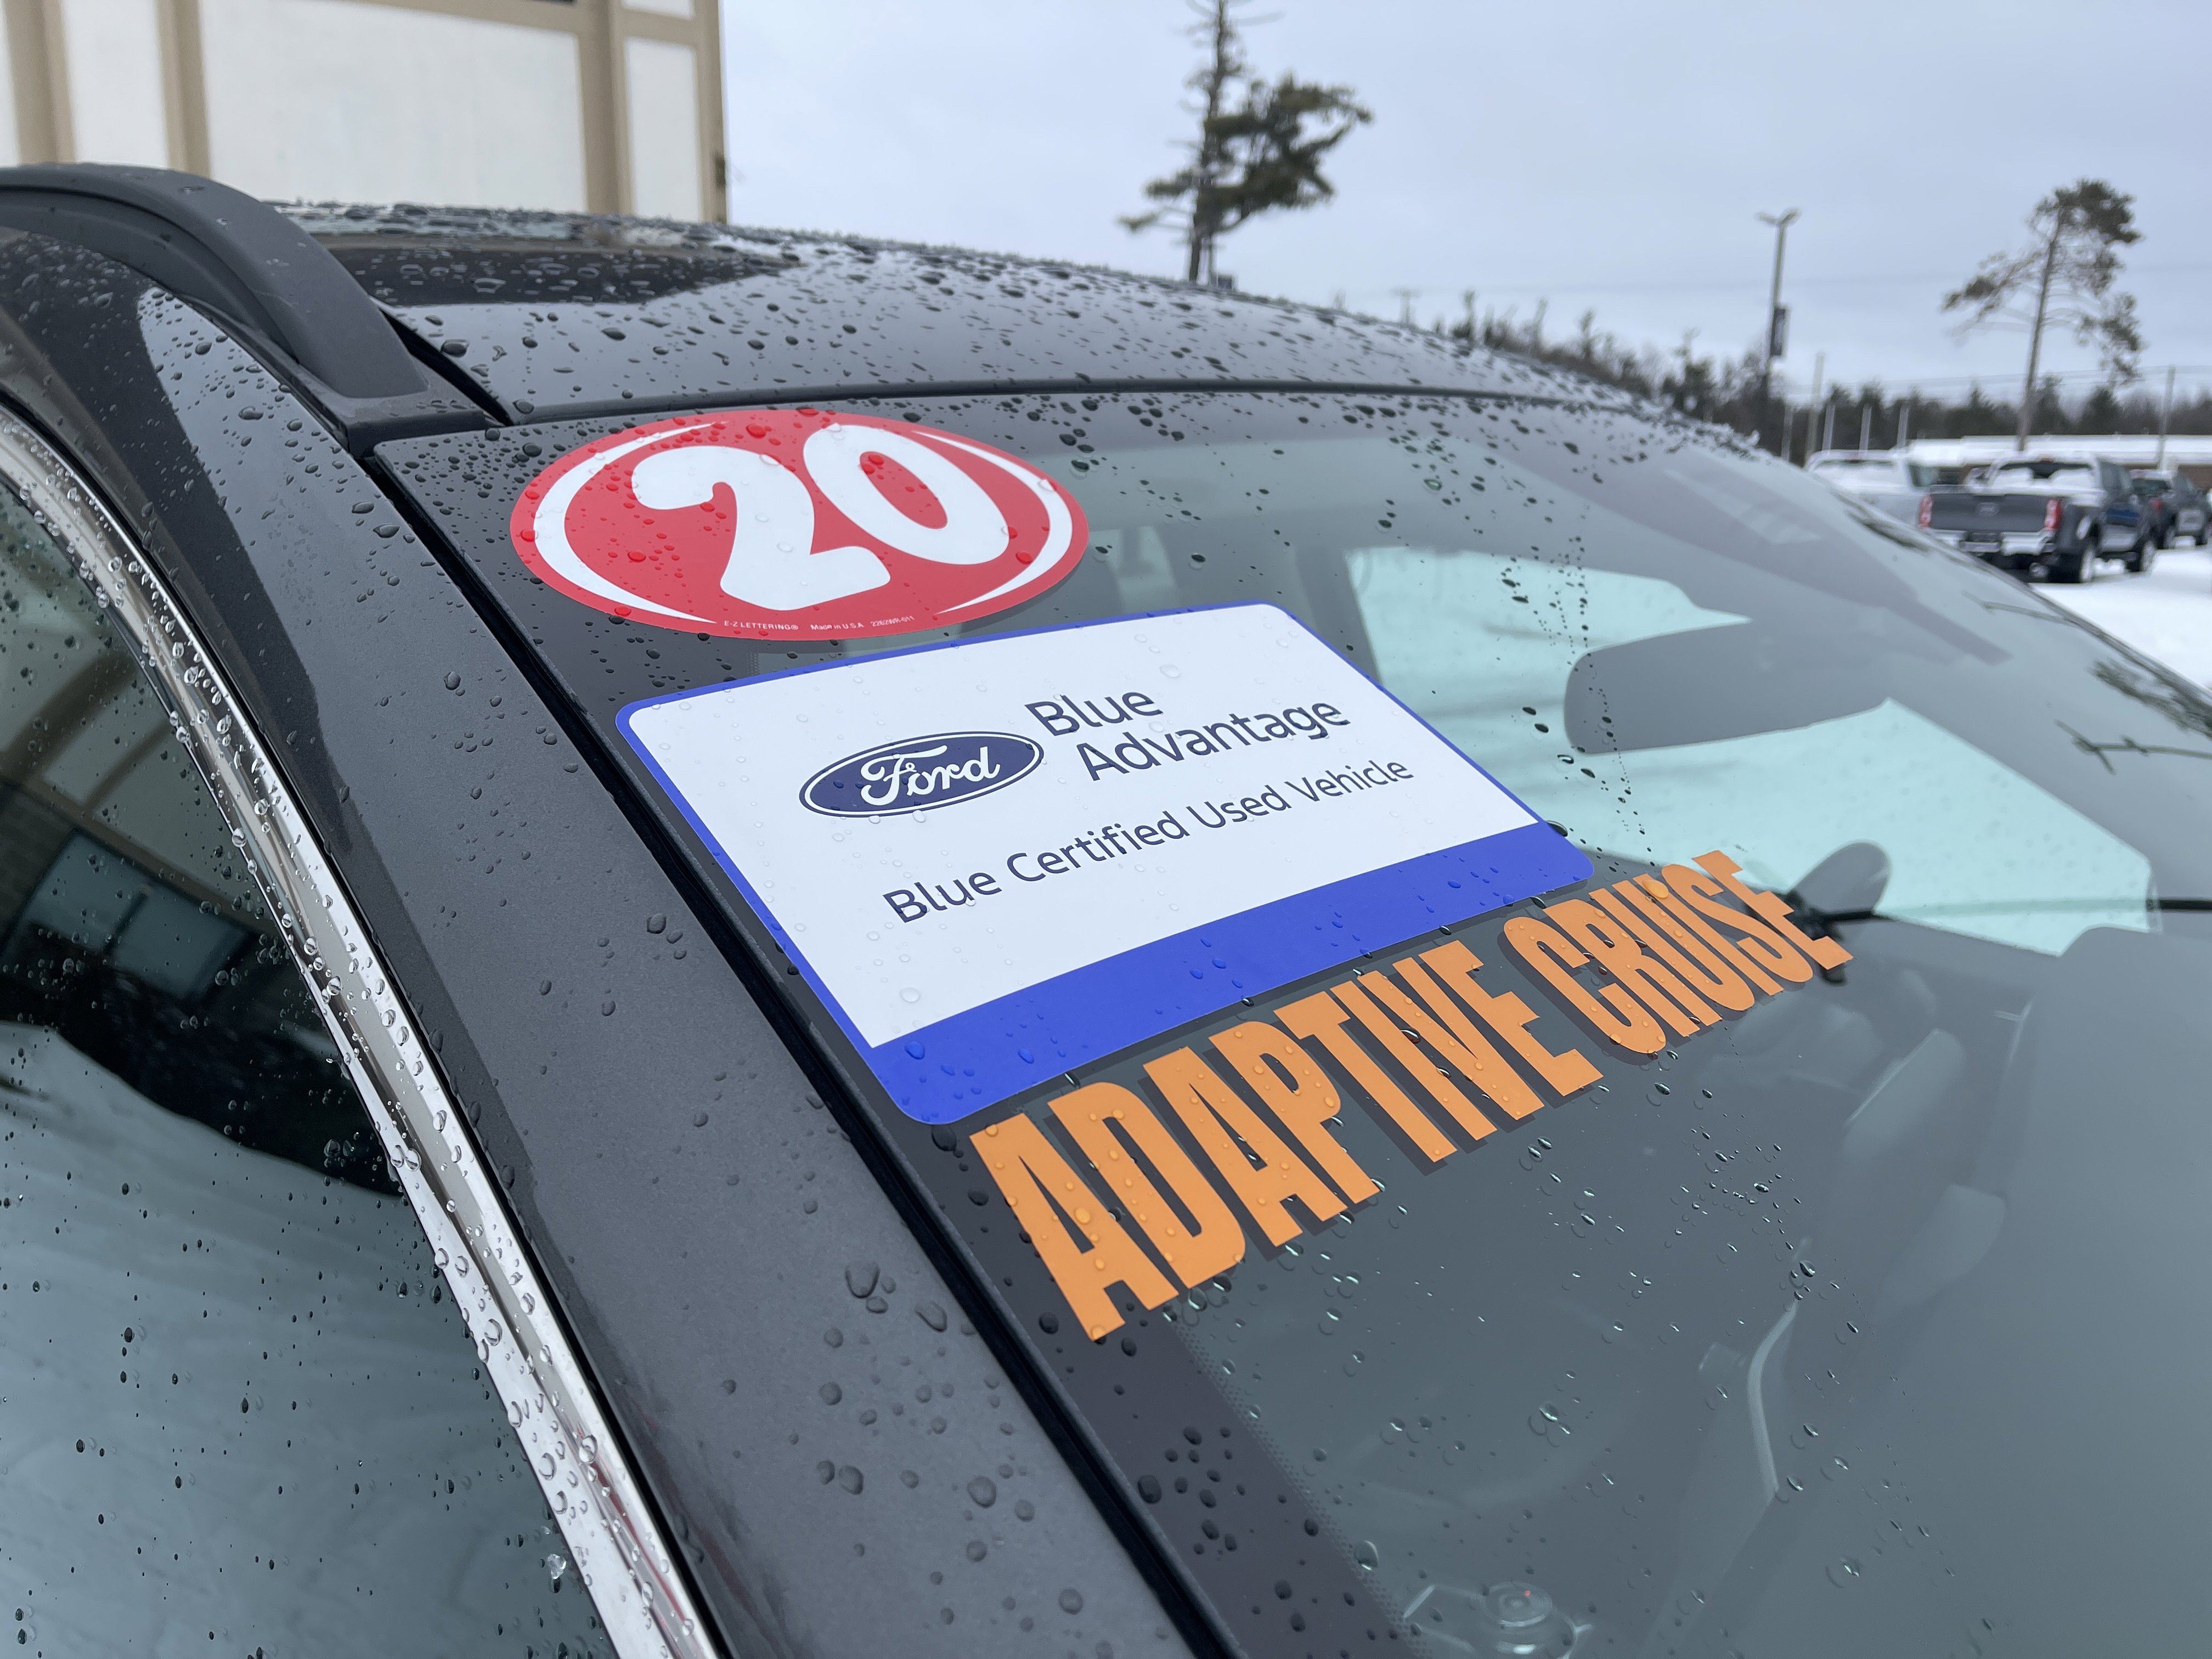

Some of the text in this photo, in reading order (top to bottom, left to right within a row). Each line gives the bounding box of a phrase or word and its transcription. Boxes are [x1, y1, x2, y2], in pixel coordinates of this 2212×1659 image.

[631, 422, 1010, 611] 20
[724, 619, 738, 628] E-Z
[1024, 691, 1164, 737] Blue
[1076, 703, 1351, 781] Advantage
[860, 744, 1001, 806] Ford
[882, 760, 1414, 924] Blue Certified Used Vehicle
[969, 850, 1853, 1341] ADAPTIVE CRUISE
